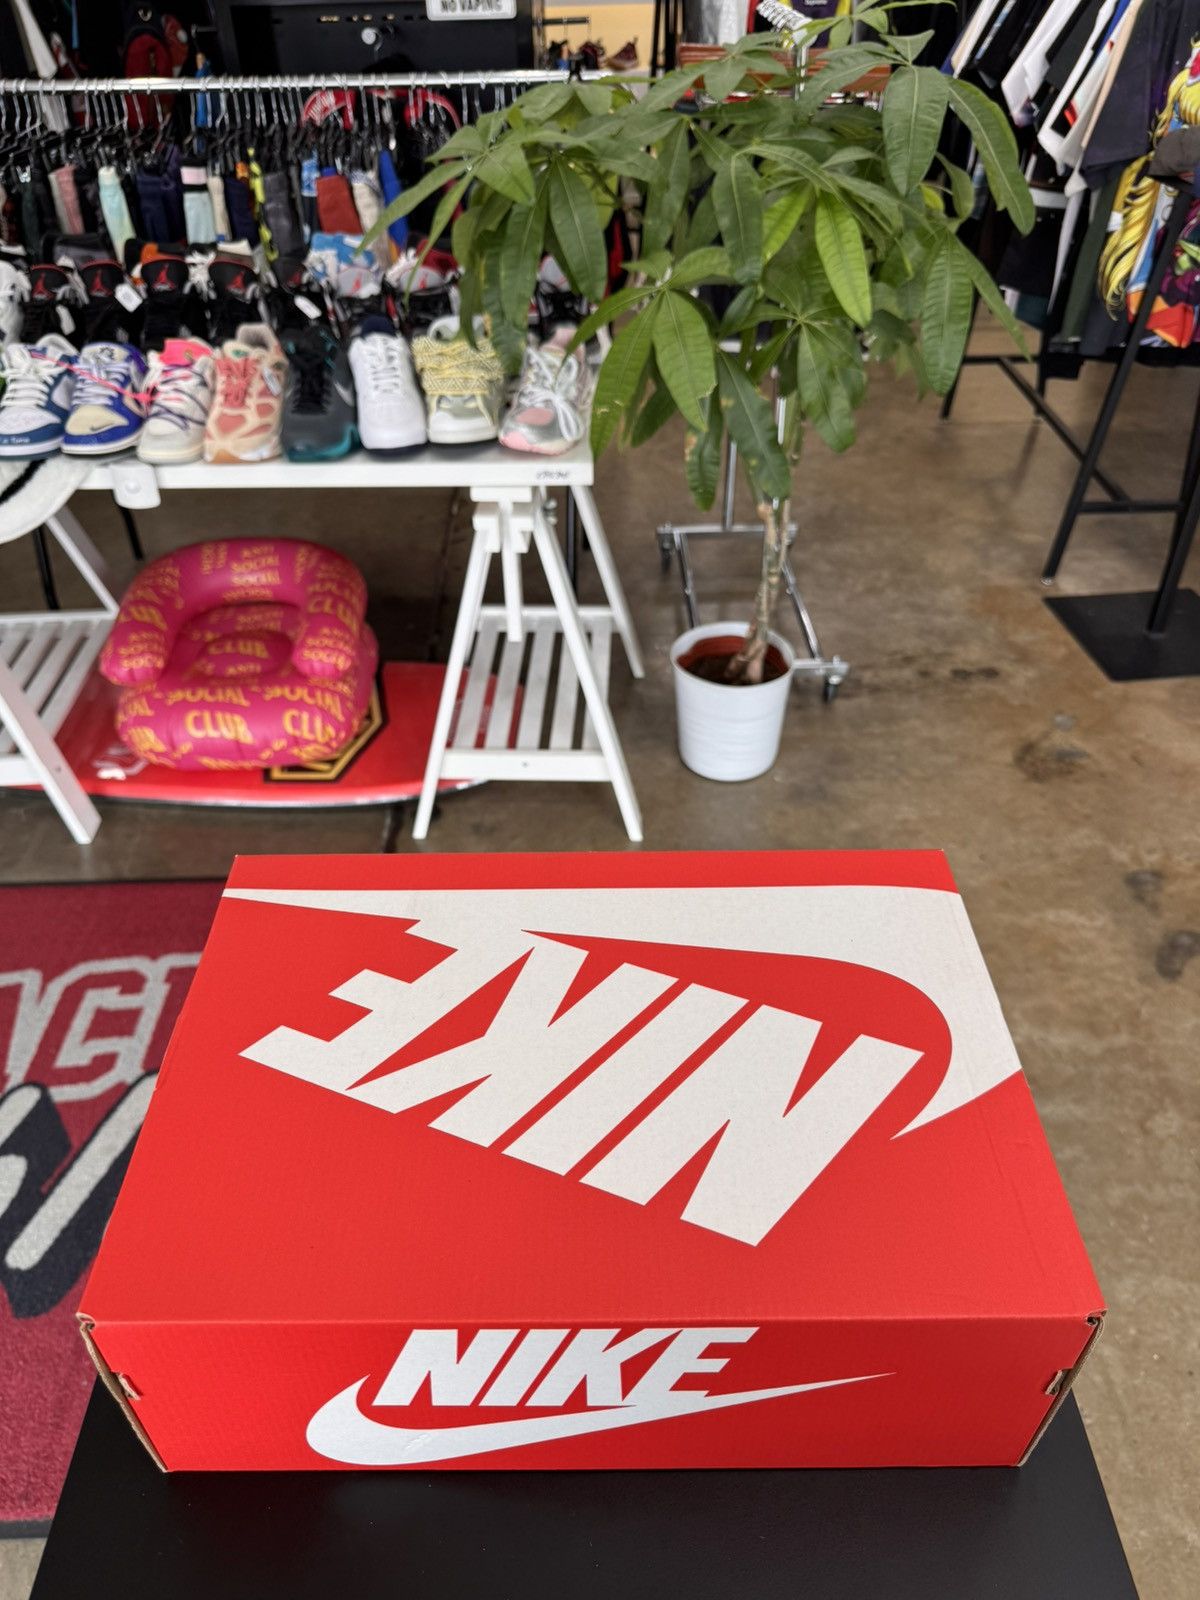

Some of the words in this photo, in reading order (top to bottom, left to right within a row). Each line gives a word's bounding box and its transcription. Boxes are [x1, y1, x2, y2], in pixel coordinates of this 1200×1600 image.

[440, 0, 457, 13] NO
[238, 916, 925, 1247] NIKE
[371, 1326, 760, 1407] NIKE
